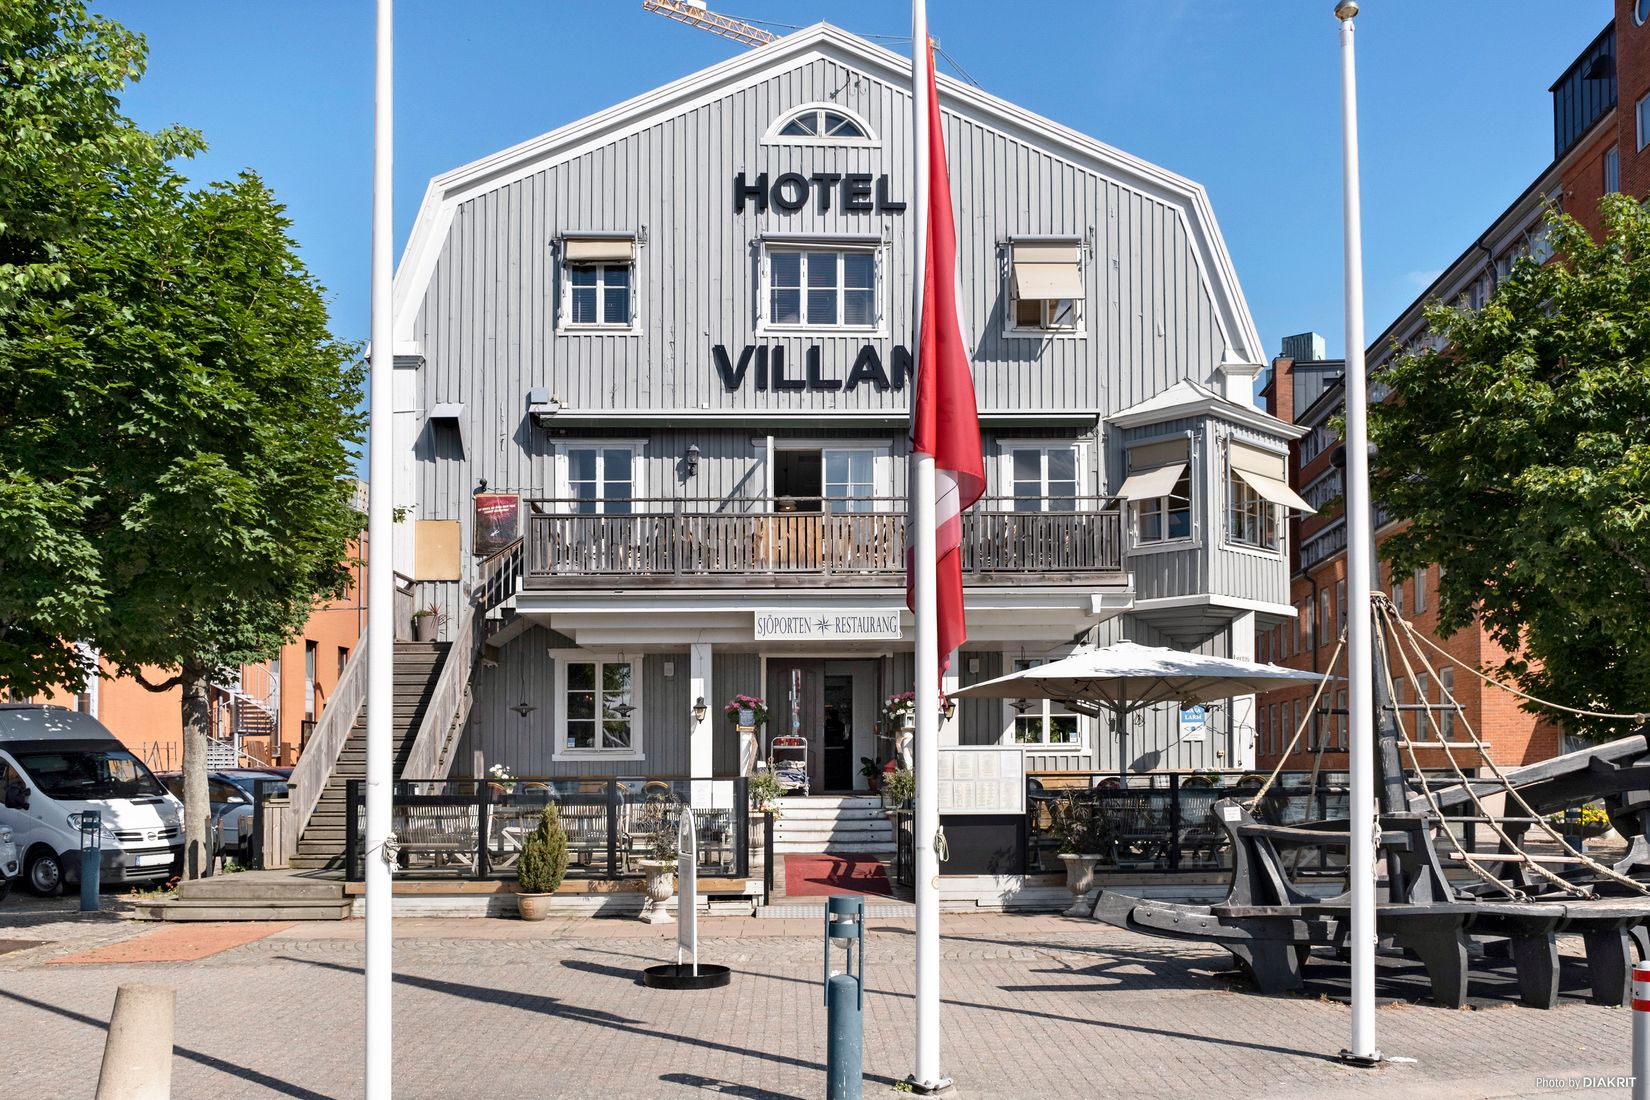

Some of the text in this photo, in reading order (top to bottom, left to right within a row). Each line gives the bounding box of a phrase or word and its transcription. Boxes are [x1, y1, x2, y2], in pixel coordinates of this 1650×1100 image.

[735, 172, 907, 211] HOTEL
[757, 614, 897, 636] SJÖPORTEN RESTAURANG
